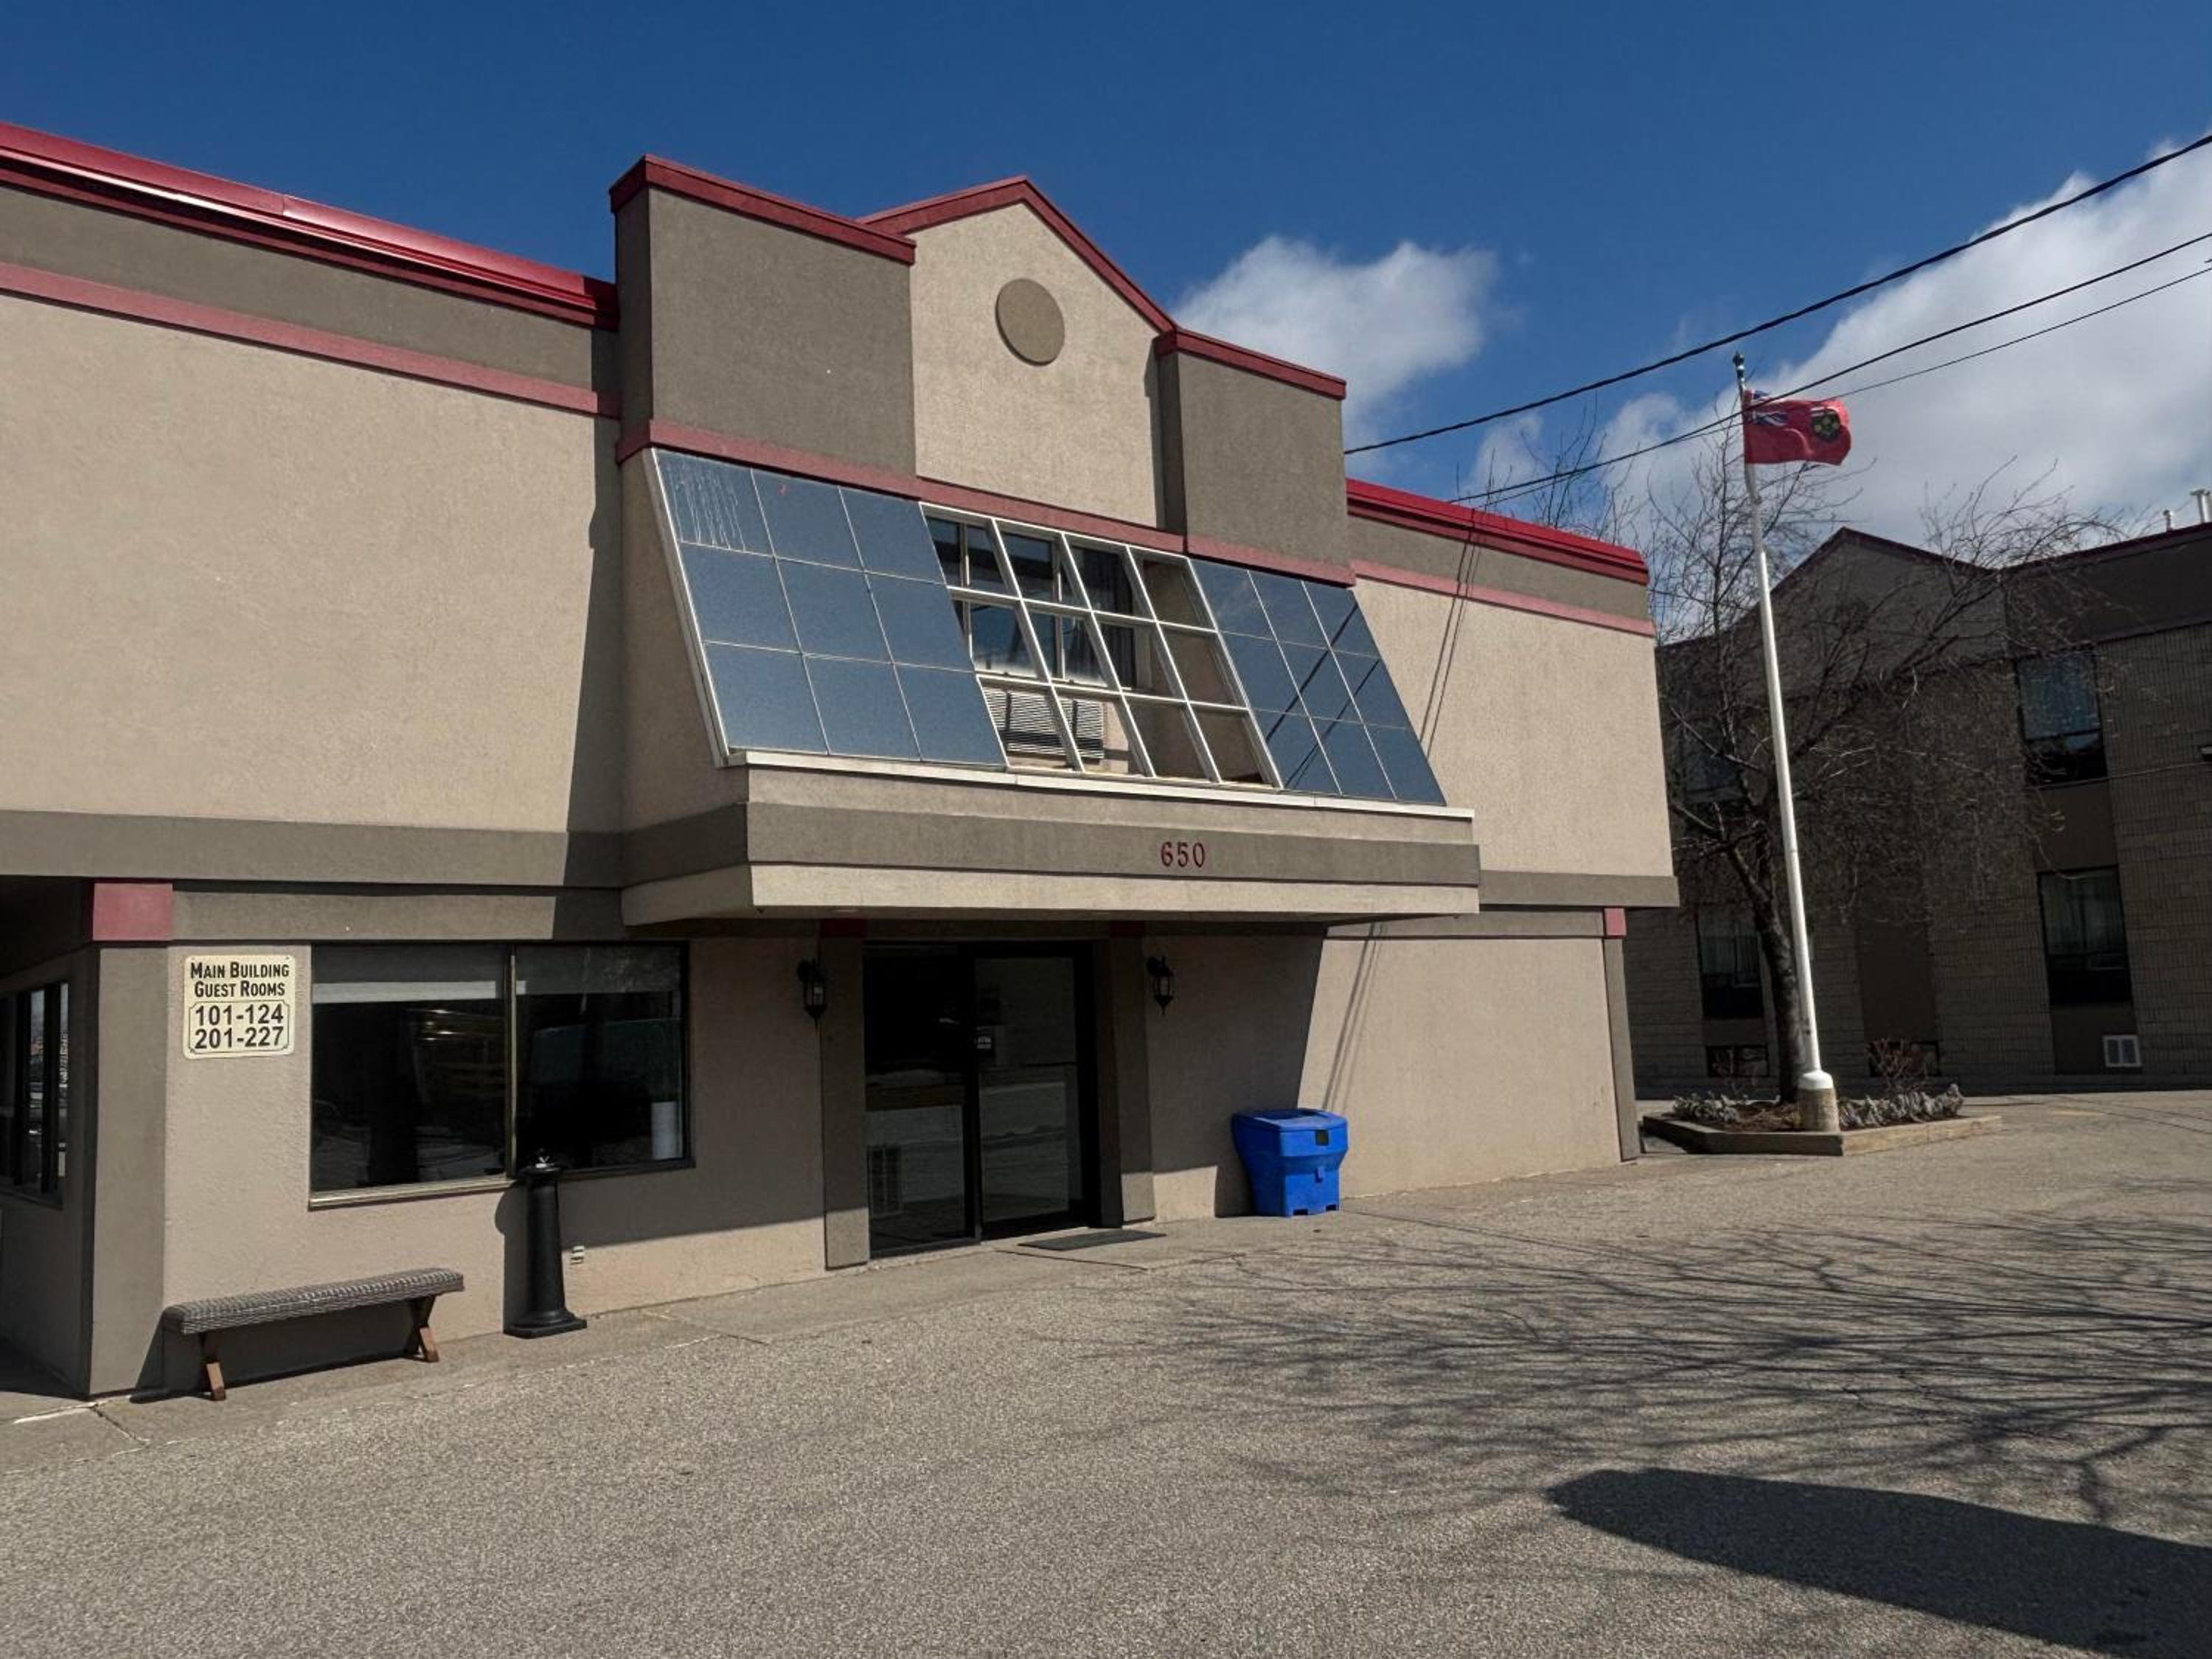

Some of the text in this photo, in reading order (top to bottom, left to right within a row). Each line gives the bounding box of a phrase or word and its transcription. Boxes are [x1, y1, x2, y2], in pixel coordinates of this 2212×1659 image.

[1161, 841, 1205, 868] 650
[190, 961, 290, 979] MAIN BUILDING
[194, 980, 285, 998] GUEST ROOMS
[195, 1004, 284, 1026] 101-124
[194, 1026, 284, 1049] 201-227
